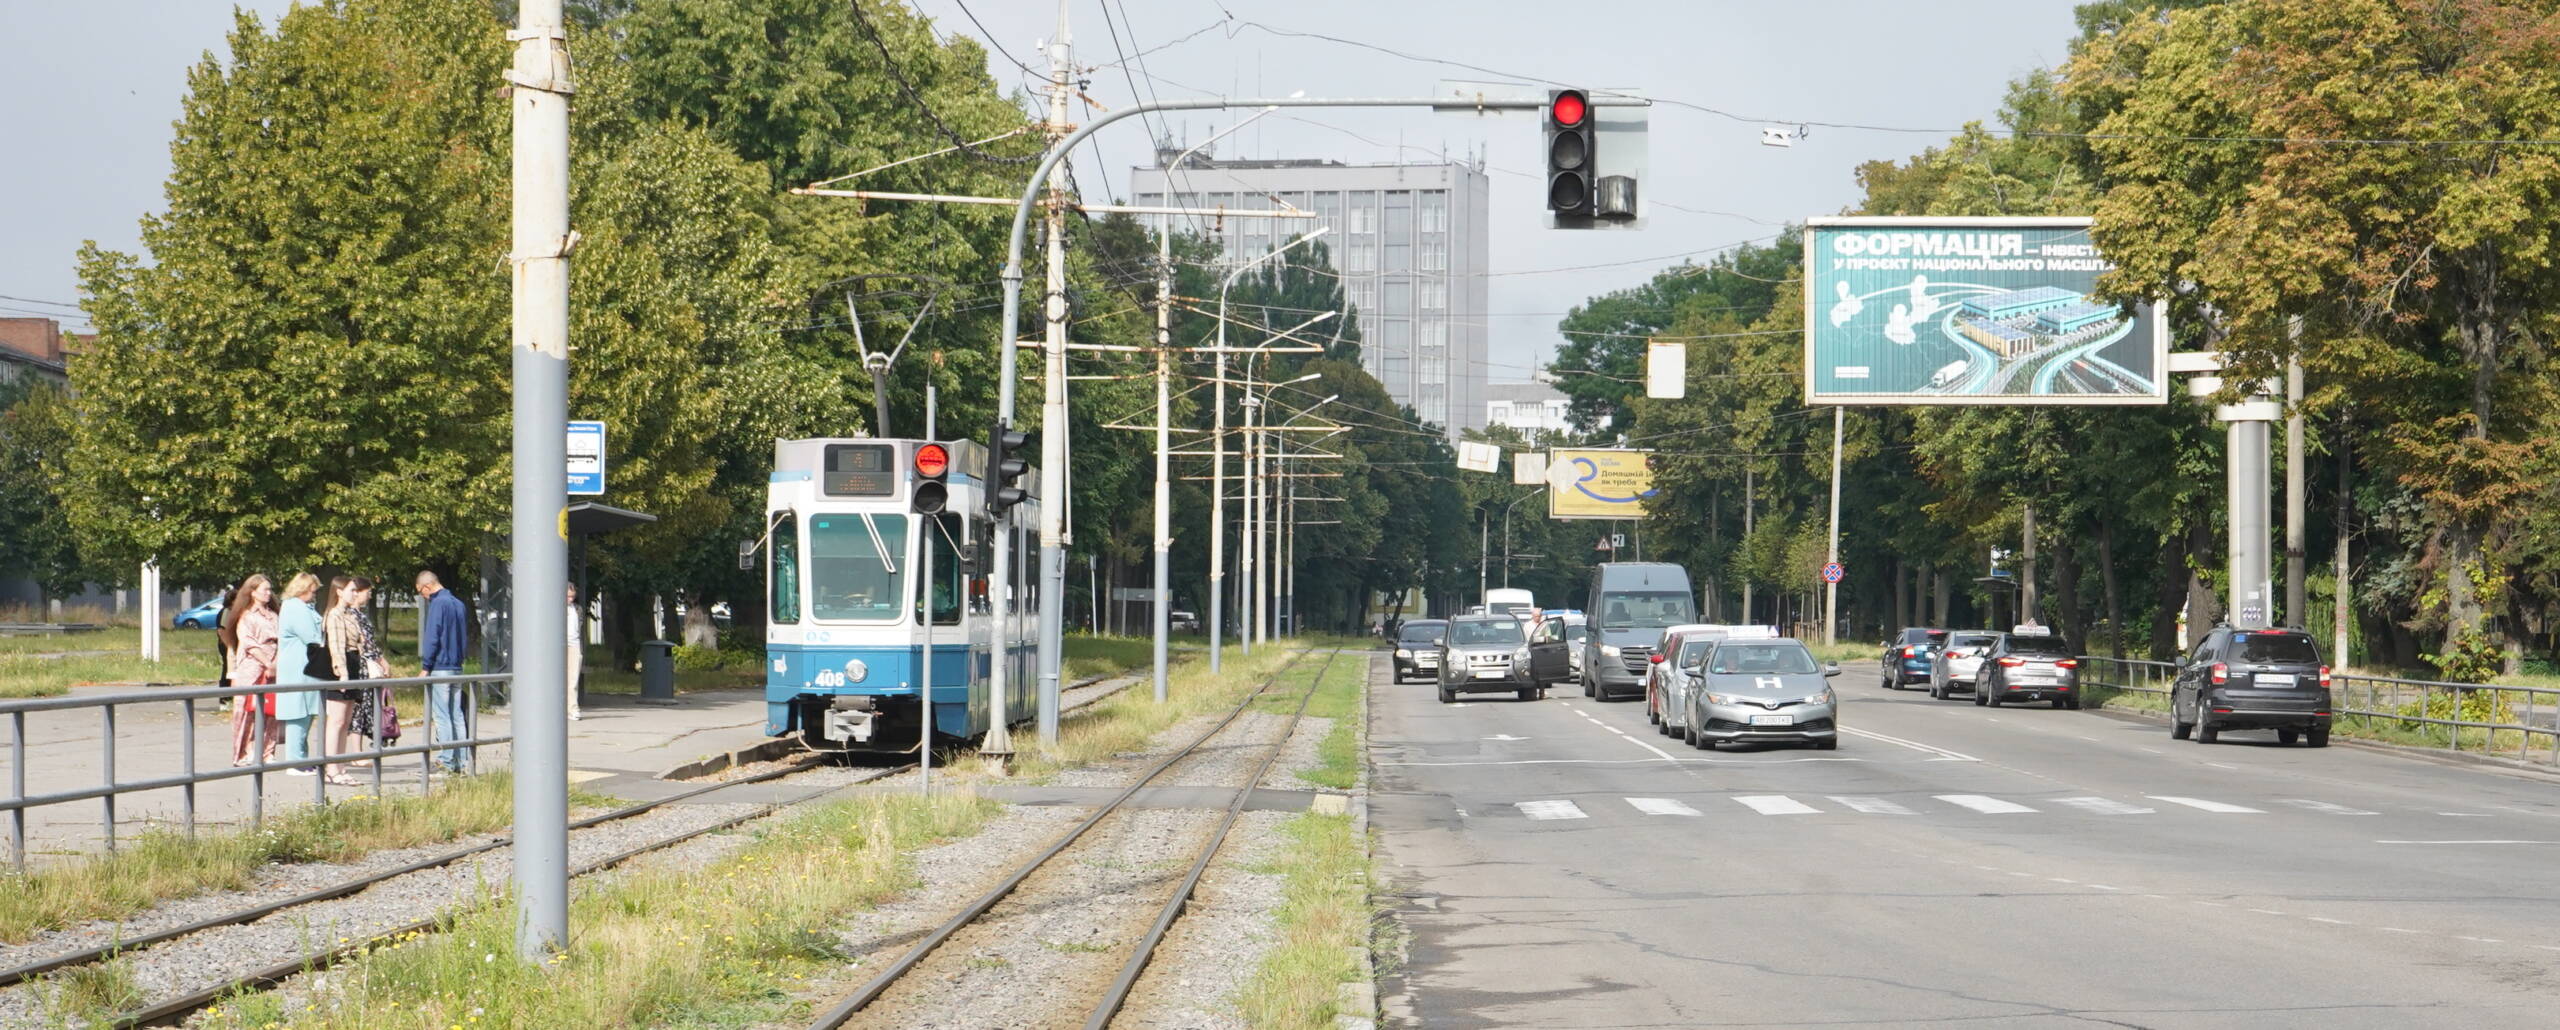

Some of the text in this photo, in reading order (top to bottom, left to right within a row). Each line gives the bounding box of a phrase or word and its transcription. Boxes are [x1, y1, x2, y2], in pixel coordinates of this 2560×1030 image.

[1834, 232, 2022, 259] ФОРМАЦІЯ
[1834, 258, 1845, 270] У
[1846, 258, 1910, 271] ПРОЄКТ
[1912, 258, 2044, 272] НАЦІОНАЛЬНОГО
[1612, 479, 1637, 487] треба
[815, 671, 845, 687] 408
